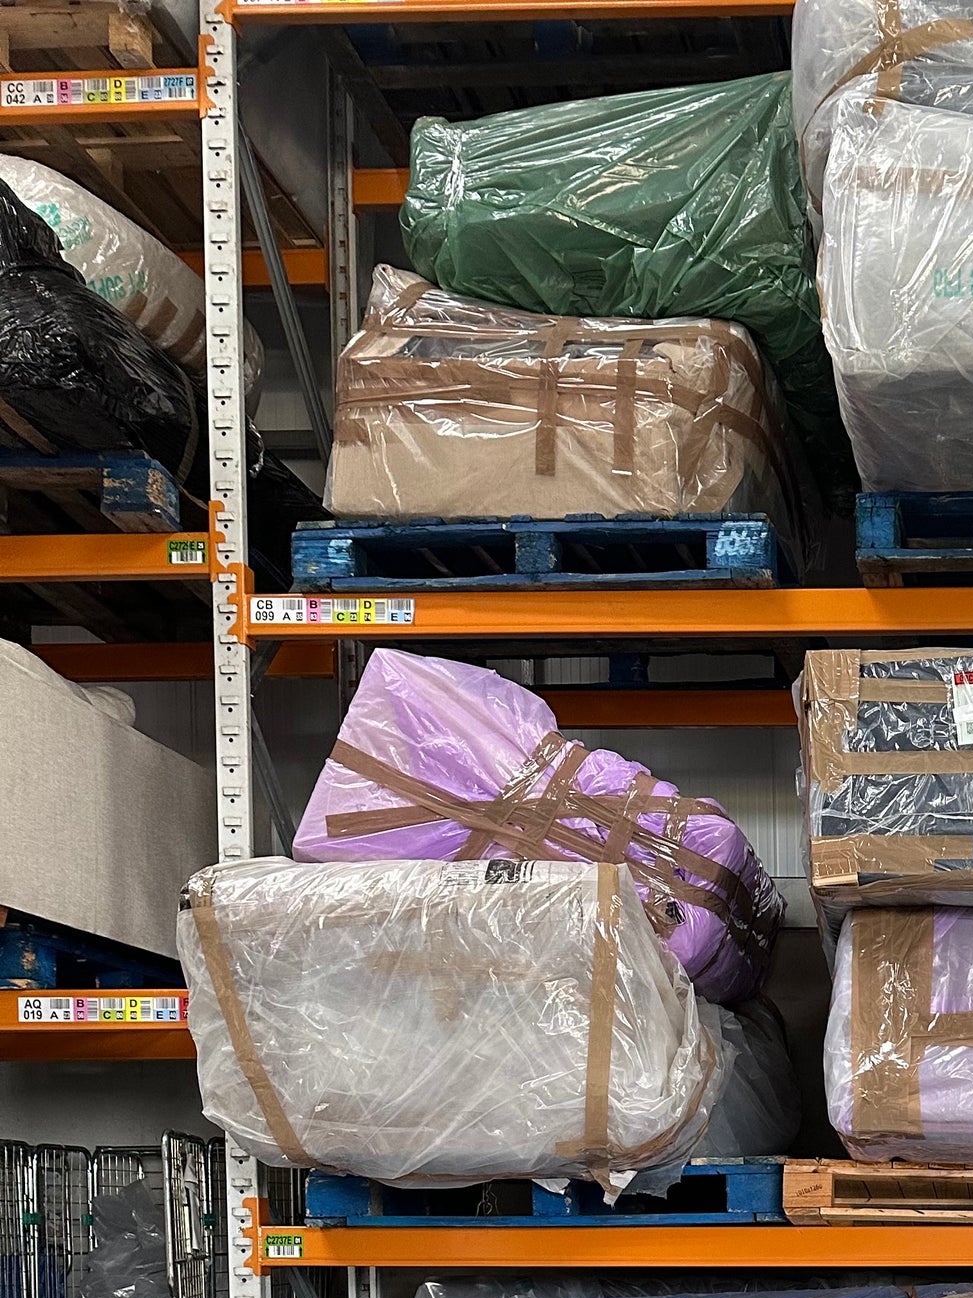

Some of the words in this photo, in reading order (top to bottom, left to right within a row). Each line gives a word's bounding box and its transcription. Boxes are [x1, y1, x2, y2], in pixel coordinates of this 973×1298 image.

[114, 80, 122, 88] D
[164, 77, 183, 86] 2727F
[8, 83, 23, 92] CC
[61, 82, 68, 90] B
[6, 93, 25, 104] 042
[87, 93, 95, 101] C
[142, 91, 148, 99] E
[257, 600, 272, 610] CB
[310, 600, 318, 608] B
[364, 601, 371, 609] D
[256, 611, 274, 621] 099
[337, 613, 345, 621] C
[391, 613, 398, 621] E
[24, 1000, 42, 1009] AQ
[77, 1000, 84, 1008] B
[130, 999, 138, 1007] D
[23, 1010, 43, 1020] 019
[103, 1011, 111, 1019] C
[157, 1011, 163, 1019] E
[267, 1236, 292, 1245] C2737E
